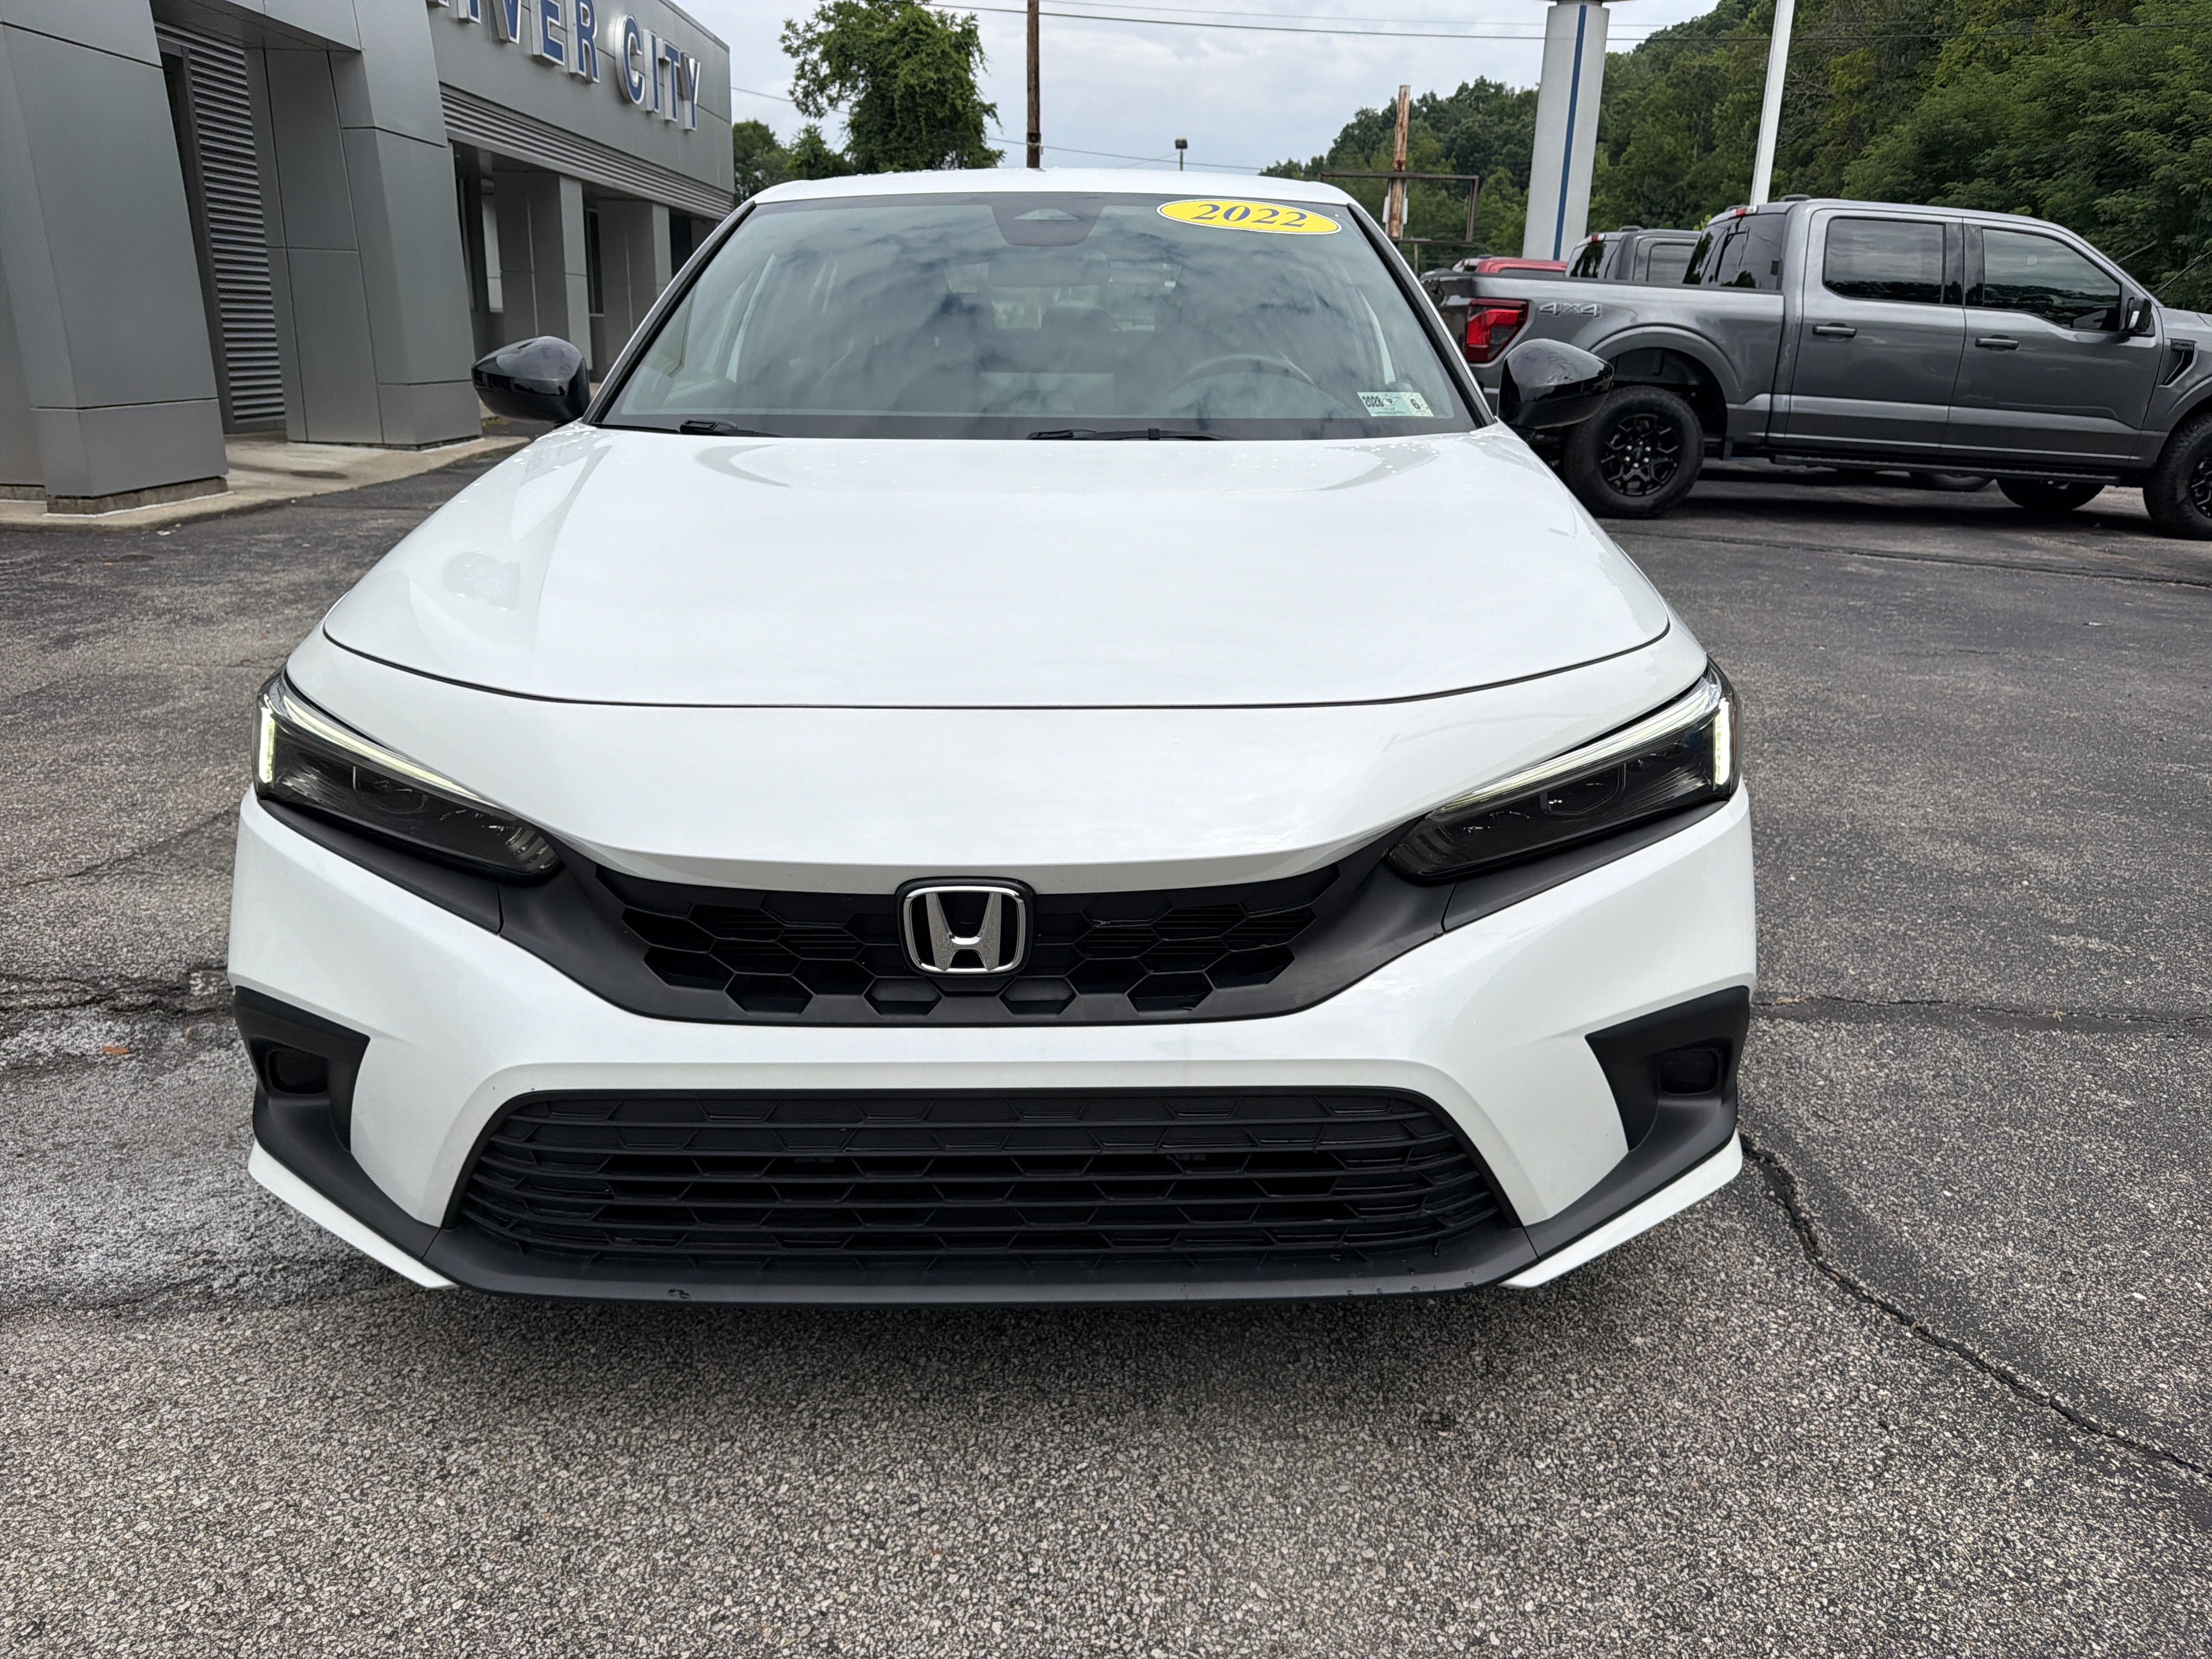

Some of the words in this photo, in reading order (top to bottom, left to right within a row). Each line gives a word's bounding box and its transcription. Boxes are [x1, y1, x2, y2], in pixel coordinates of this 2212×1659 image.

[615, 15, 701, 131] CITY
[1190, 204, 1307, 228] 2022
[1410, 398, 1421, 410] 6
